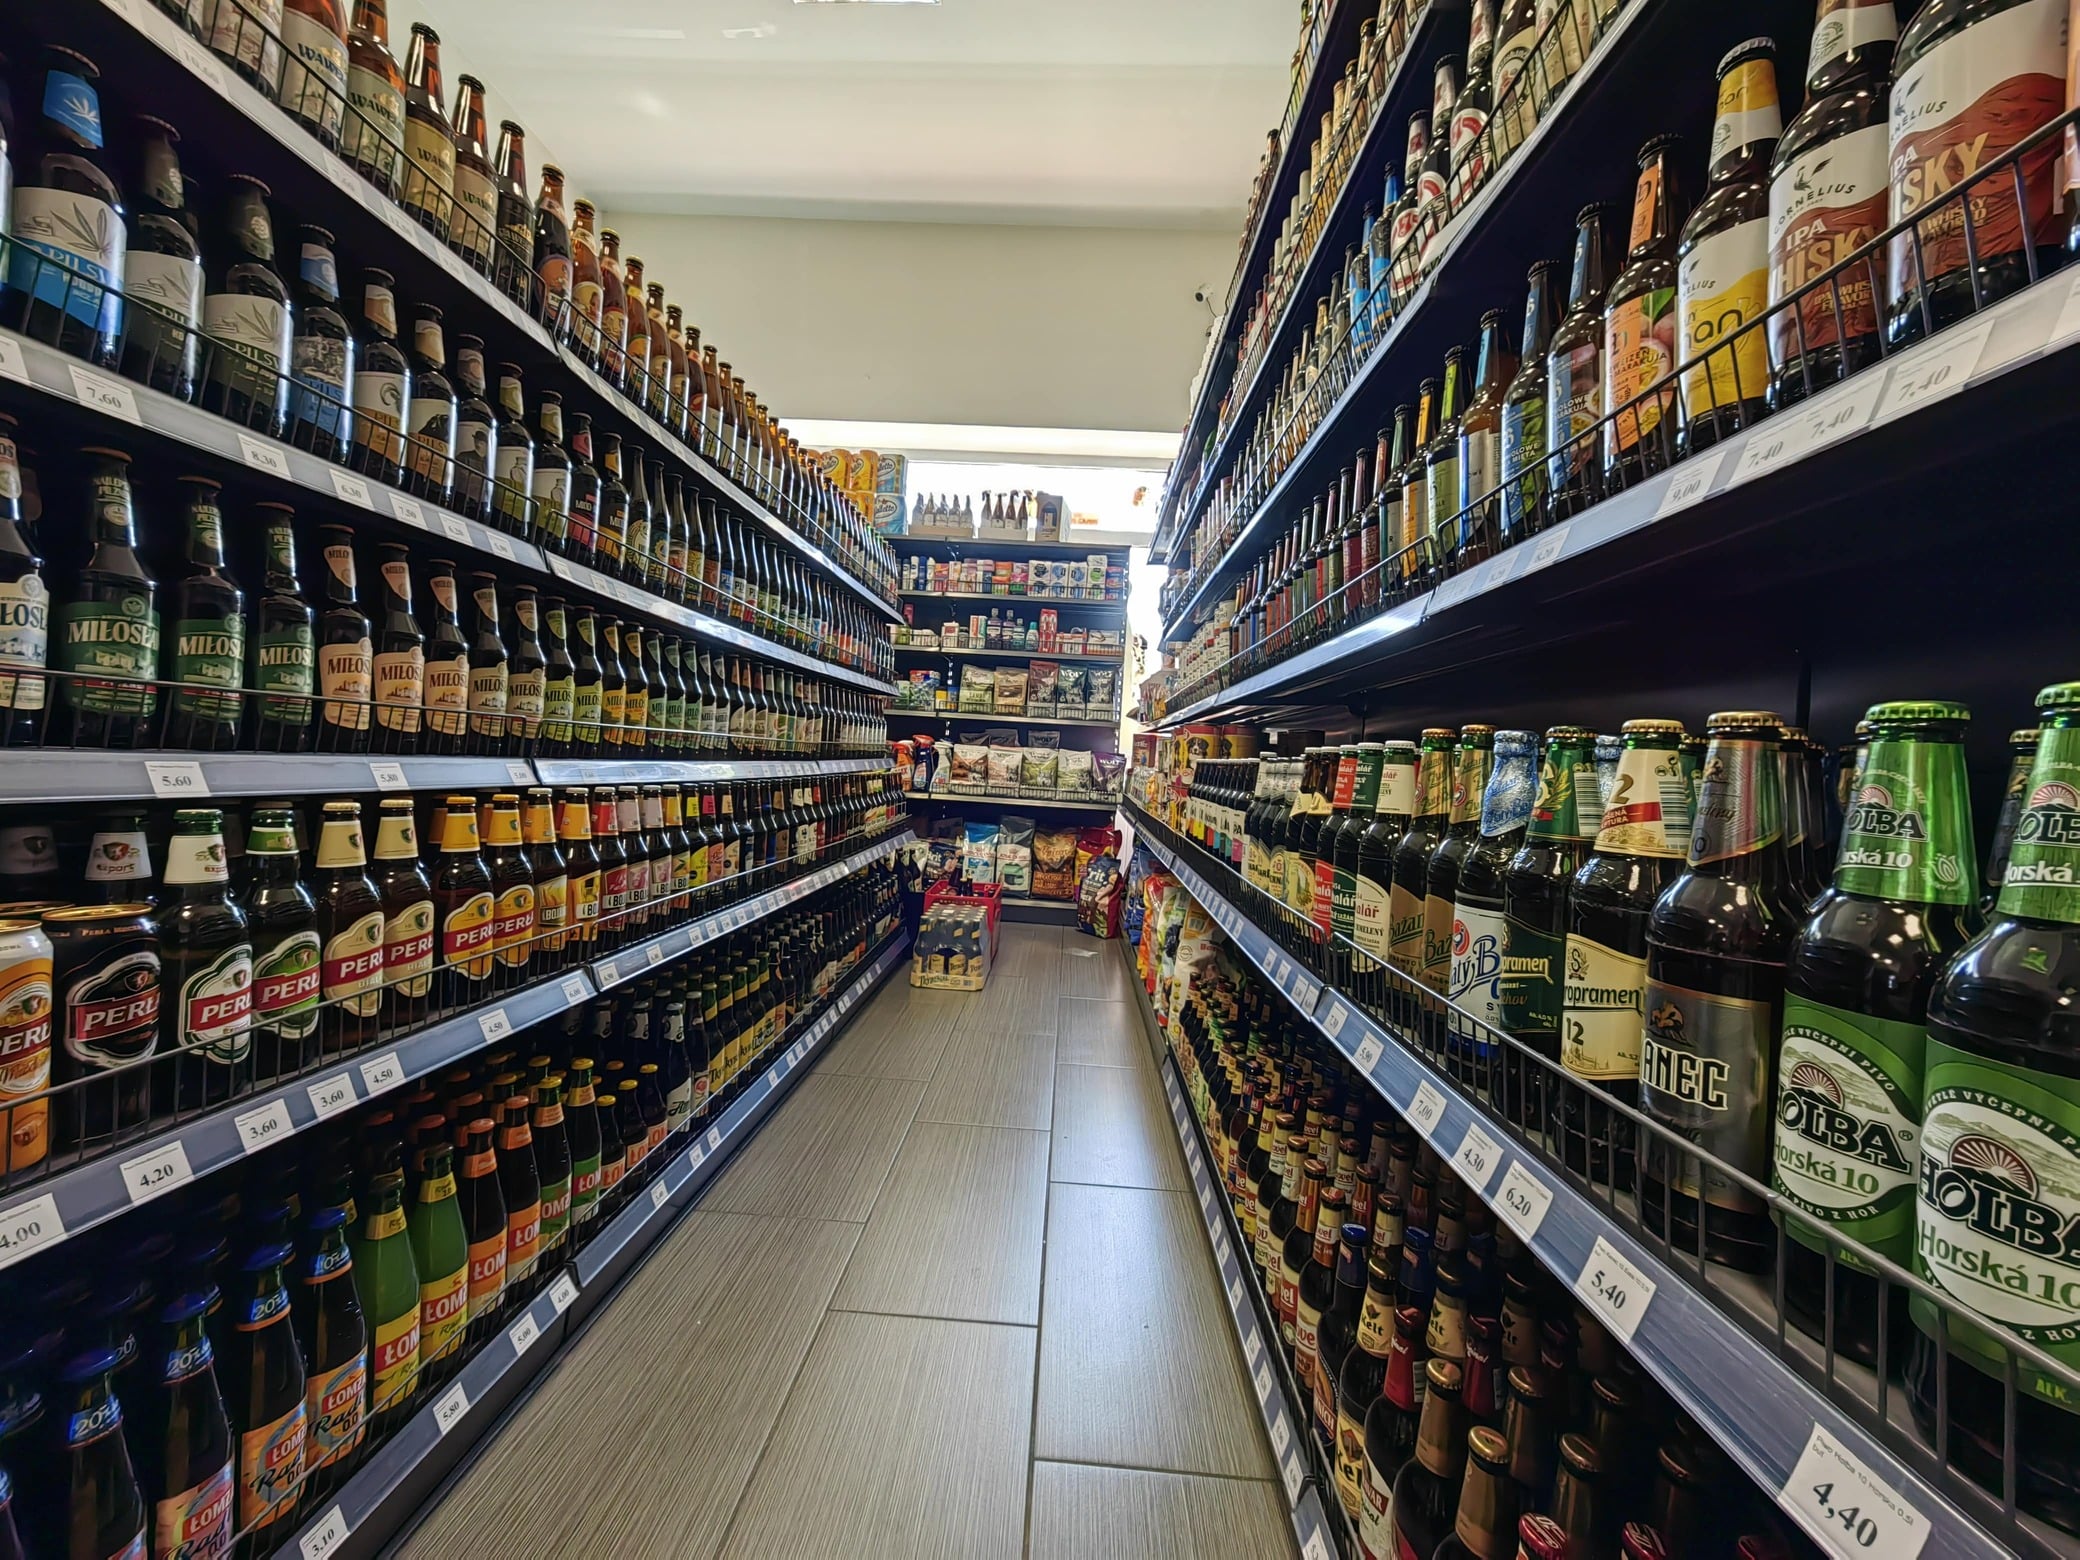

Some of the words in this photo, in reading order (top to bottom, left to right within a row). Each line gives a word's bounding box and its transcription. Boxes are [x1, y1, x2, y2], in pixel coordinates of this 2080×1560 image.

[1786, 217, 1828, 252] IPA
[1884, 852, 1913, 868] 10
[1565, 1017, 1585, 1046] 12
[1860, 1059, 1896, 1092] PIVO
[320, 1089, 345, 1109] 3,60
[1415, 1098, 1434, 1121] 7,00
[250, 1118, 278, 1140] 3,60
[1463, 1147, 1486, 1173] 4,30
[139, 1163, 175, 1188] 4,20
[1842, 1168, 1880, 1195] 10
[1506, 1186, 1533, 1218] 6,20
[1848, 1204, 1880, 1221] HOR
[0, 1220, 42, 1250] 4,00
[1919, 1218, 2030, 1295] Horská
[1590, 1269, 1627, 1310] 5,40
[1812, 1482, 1878, 1548] 4,40
[311, 1526, 336, 1558] 3,10
